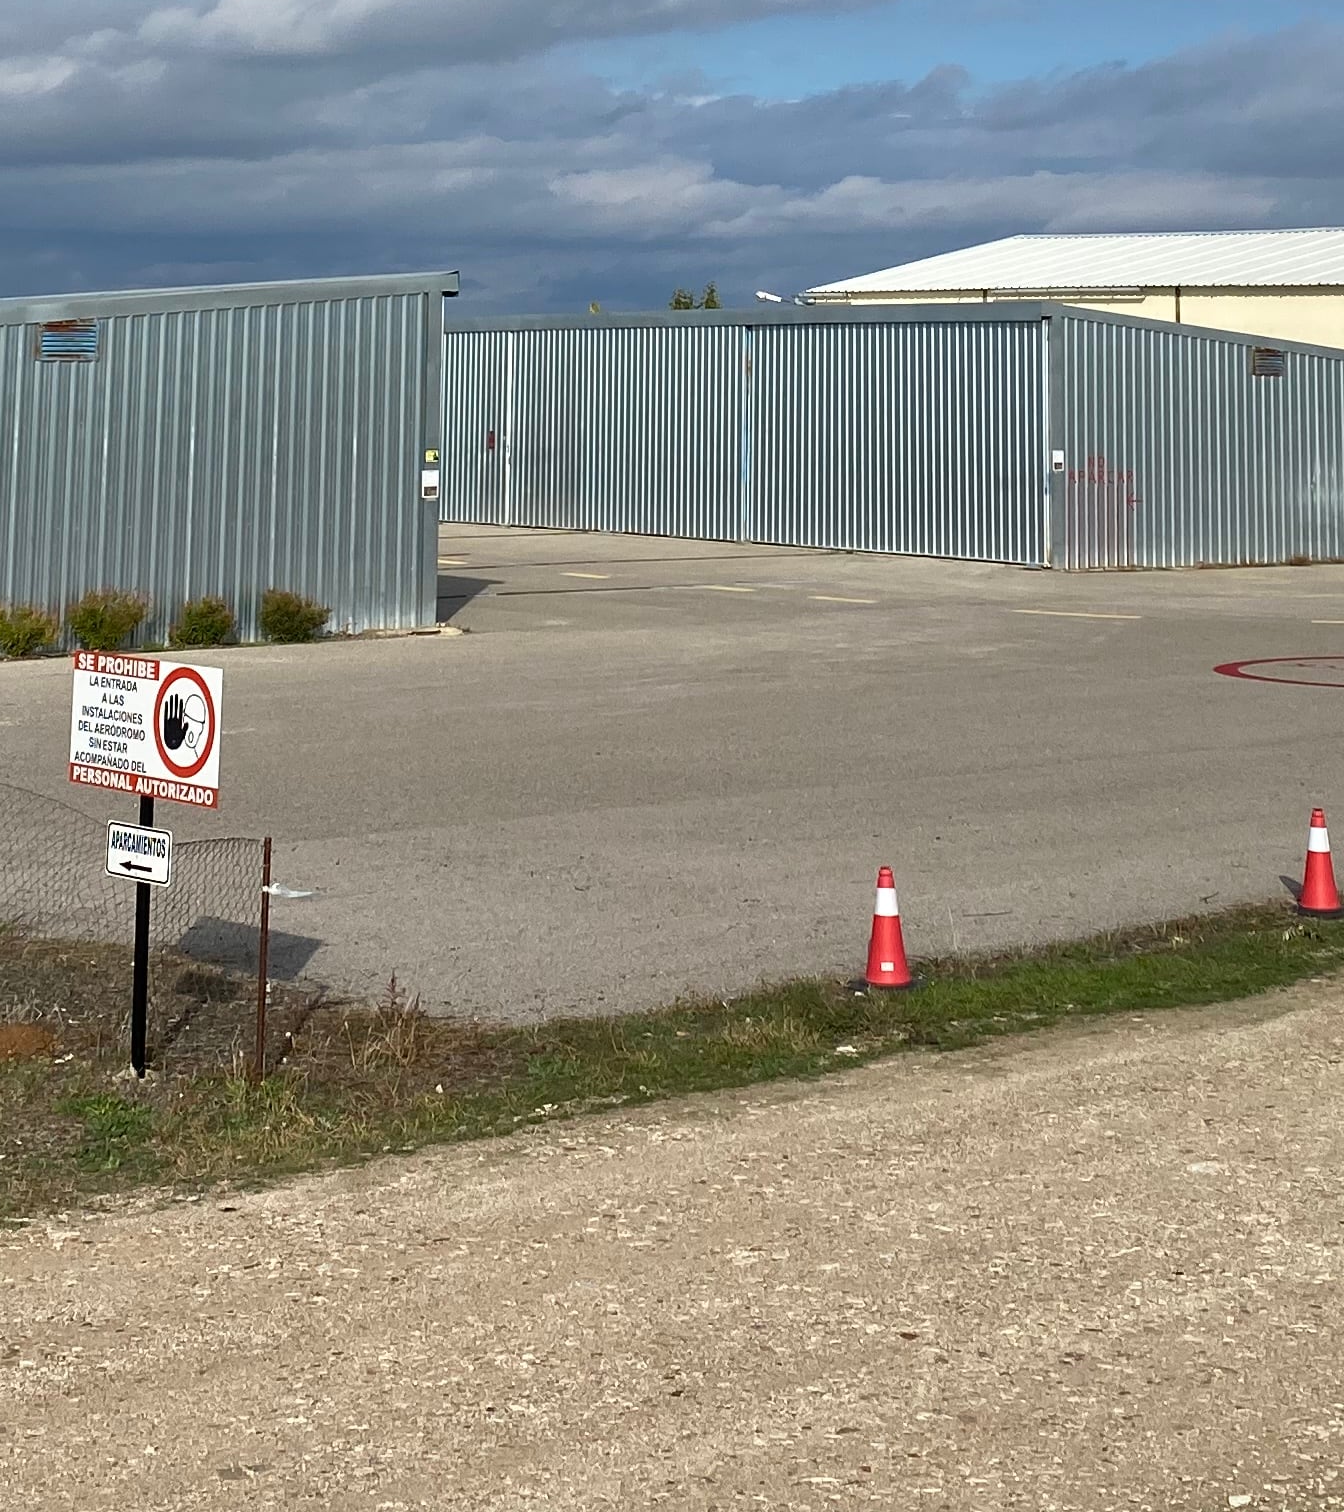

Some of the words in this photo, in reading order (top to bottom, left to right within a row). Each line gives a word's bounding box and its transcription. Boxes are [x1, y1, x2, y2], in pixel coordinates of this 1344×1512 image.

[1087, 455, 1105, 469] NO
[78, 652, 96, 671] SE
[97, 656, 156, 679] PROHIBE
[89, 676, 100, 688] LA
[101, 677, 138, 693] ENTRADA
[101, 694, 108, 704] A
[109, 695, 125, 706] LAS
[81, 706, 143, 725] INSTALACIONES
[78, 720, 94, 733] DEL
[89, 738, 102, 749] SIN
[102, 739, 128, 754] ESTAR
[74, 751, 130, 771] ACOMPAÑADO
[130, 761, 147, 774] DEL
[73, 768, 133, 791] PERSONAL
[135, 780, 214, 806] AUTORIZADO
[111, 830, 166, 858] APARCAMIENTOS
